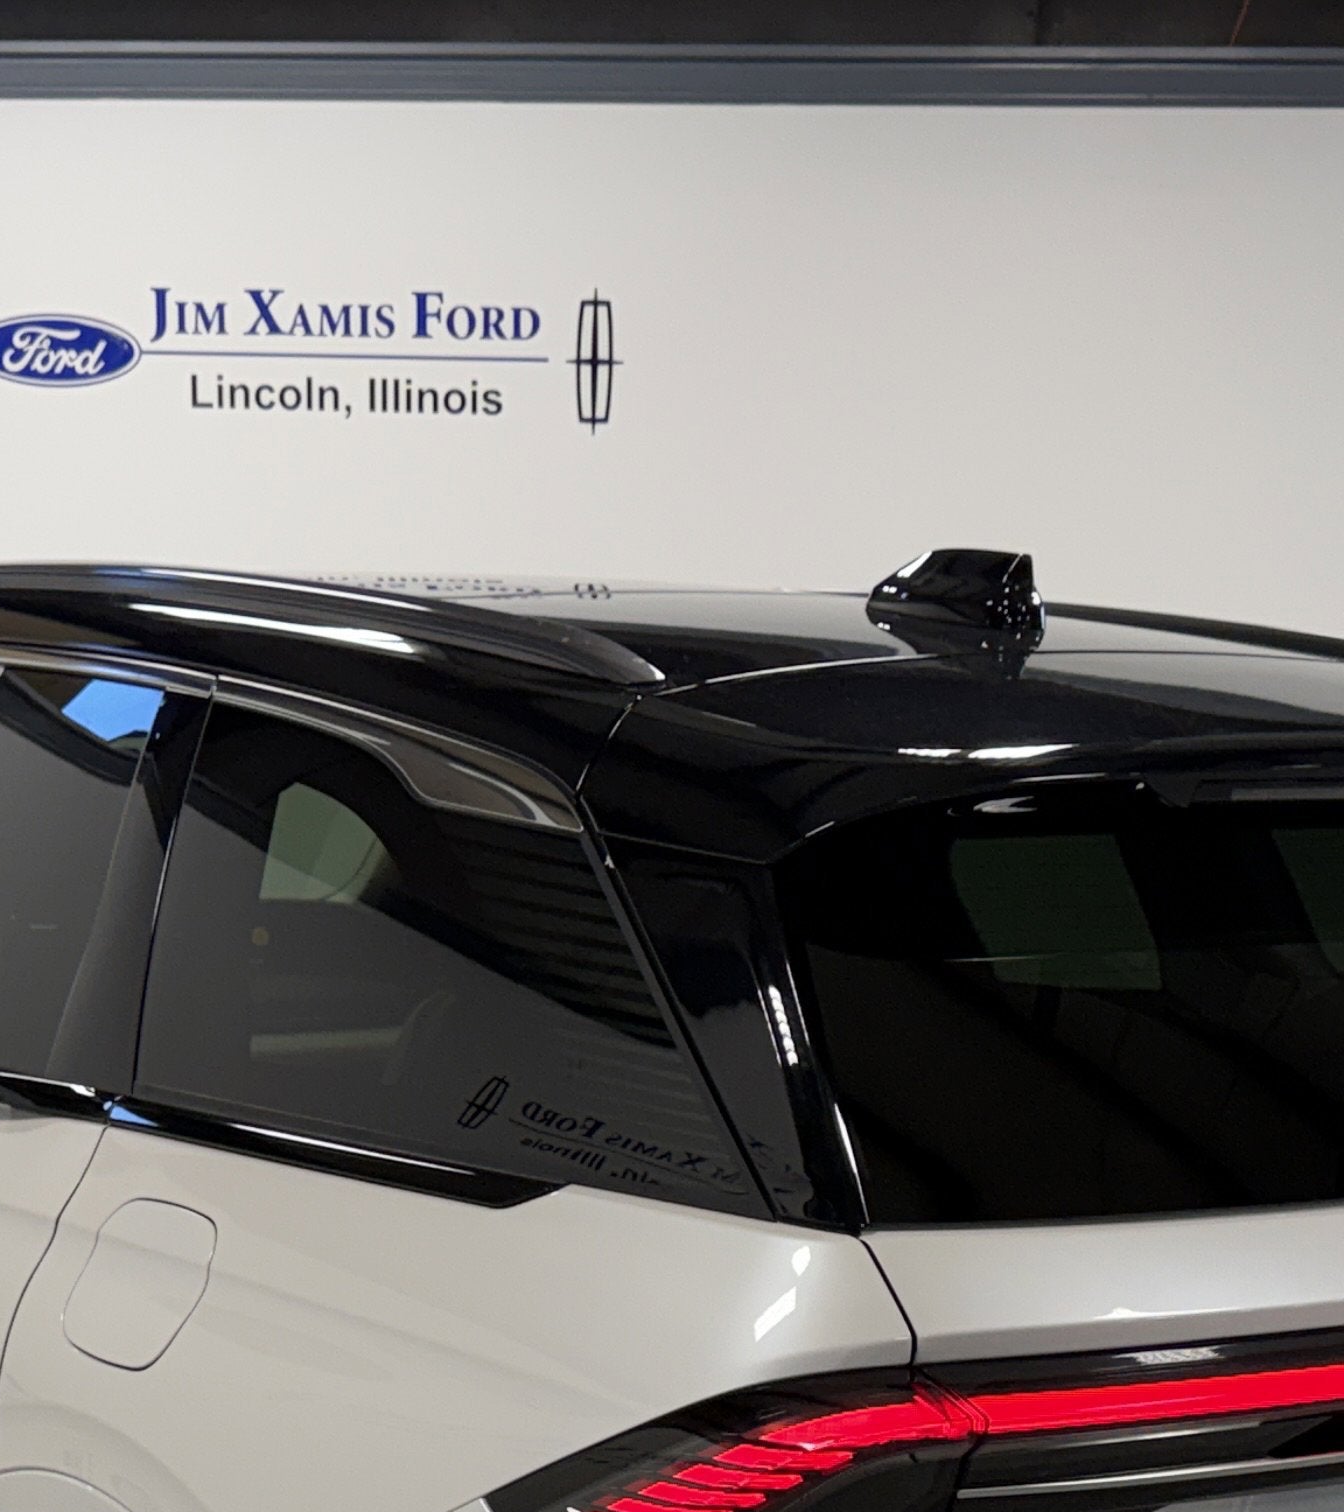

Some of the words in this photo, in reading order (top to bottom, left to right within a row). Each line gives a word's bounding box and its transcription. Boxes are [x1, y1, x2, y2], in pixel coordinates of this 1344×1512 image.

[150, 287, 227, 343] JIM
[244, 289, 395, 339] XAMIS
[412, 291, 541, 340] FORD
[2, 326, 106, 377] Ford
[190, 374, 351, 419] Lincoln,
[368, 377, 503, 416] Illinois
